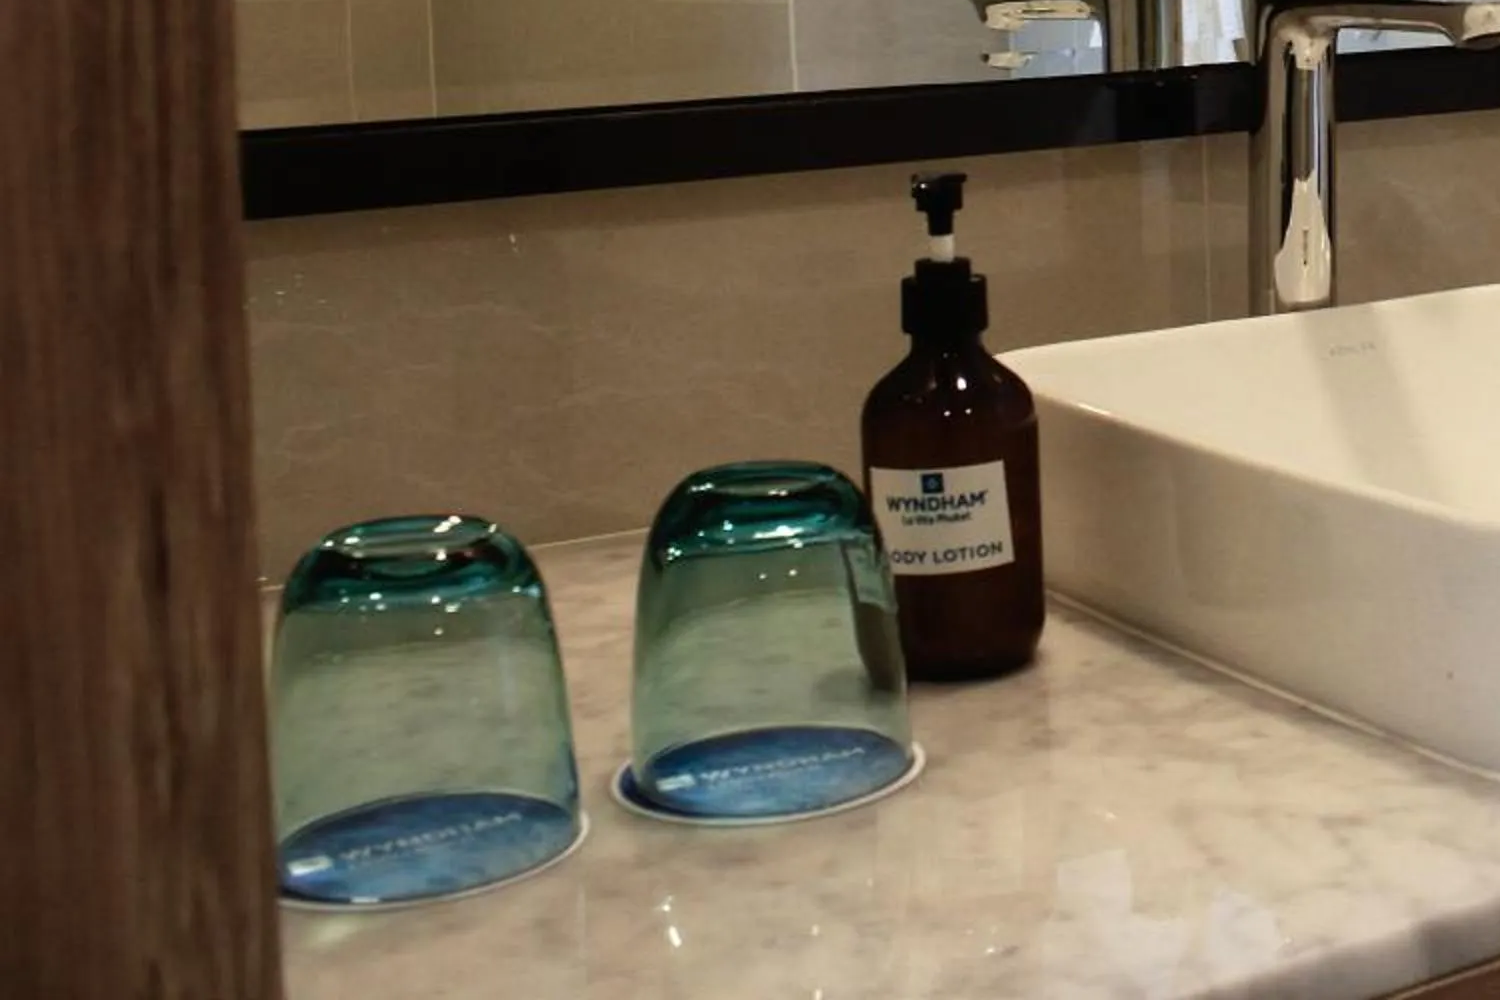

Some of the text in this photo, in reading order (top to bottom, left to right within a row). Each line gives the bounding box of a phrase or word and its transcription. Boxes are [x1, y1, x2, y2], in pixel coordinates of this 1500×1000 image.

[886, 490, 987, 512] WYNDHAM
[890, 541, 1004, 564] ODY LOTION
